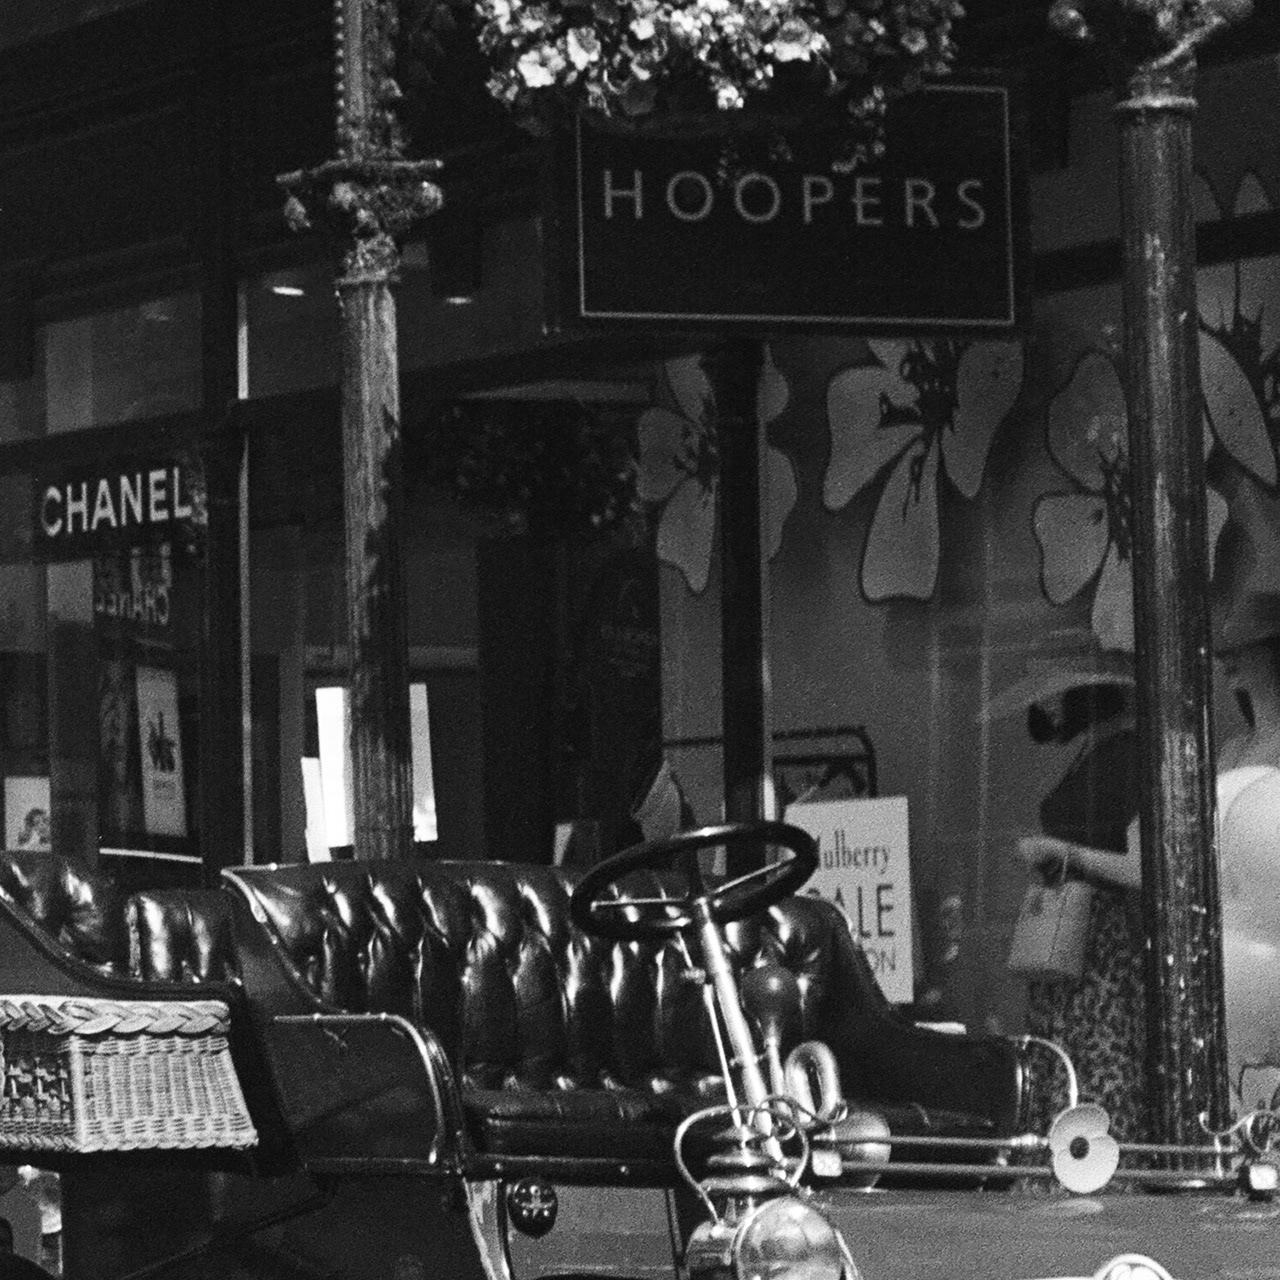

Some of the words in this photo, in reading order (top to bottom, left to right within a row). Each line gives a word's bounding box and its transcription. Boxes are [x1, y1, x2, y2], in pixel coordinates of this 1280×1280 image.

[603, 168, 986, 229] HOOPERS
[41, 466, 193, 538] CHANEL
[816, 829, 889, 875] ulberry
[806, 883, 896, 938] LE
